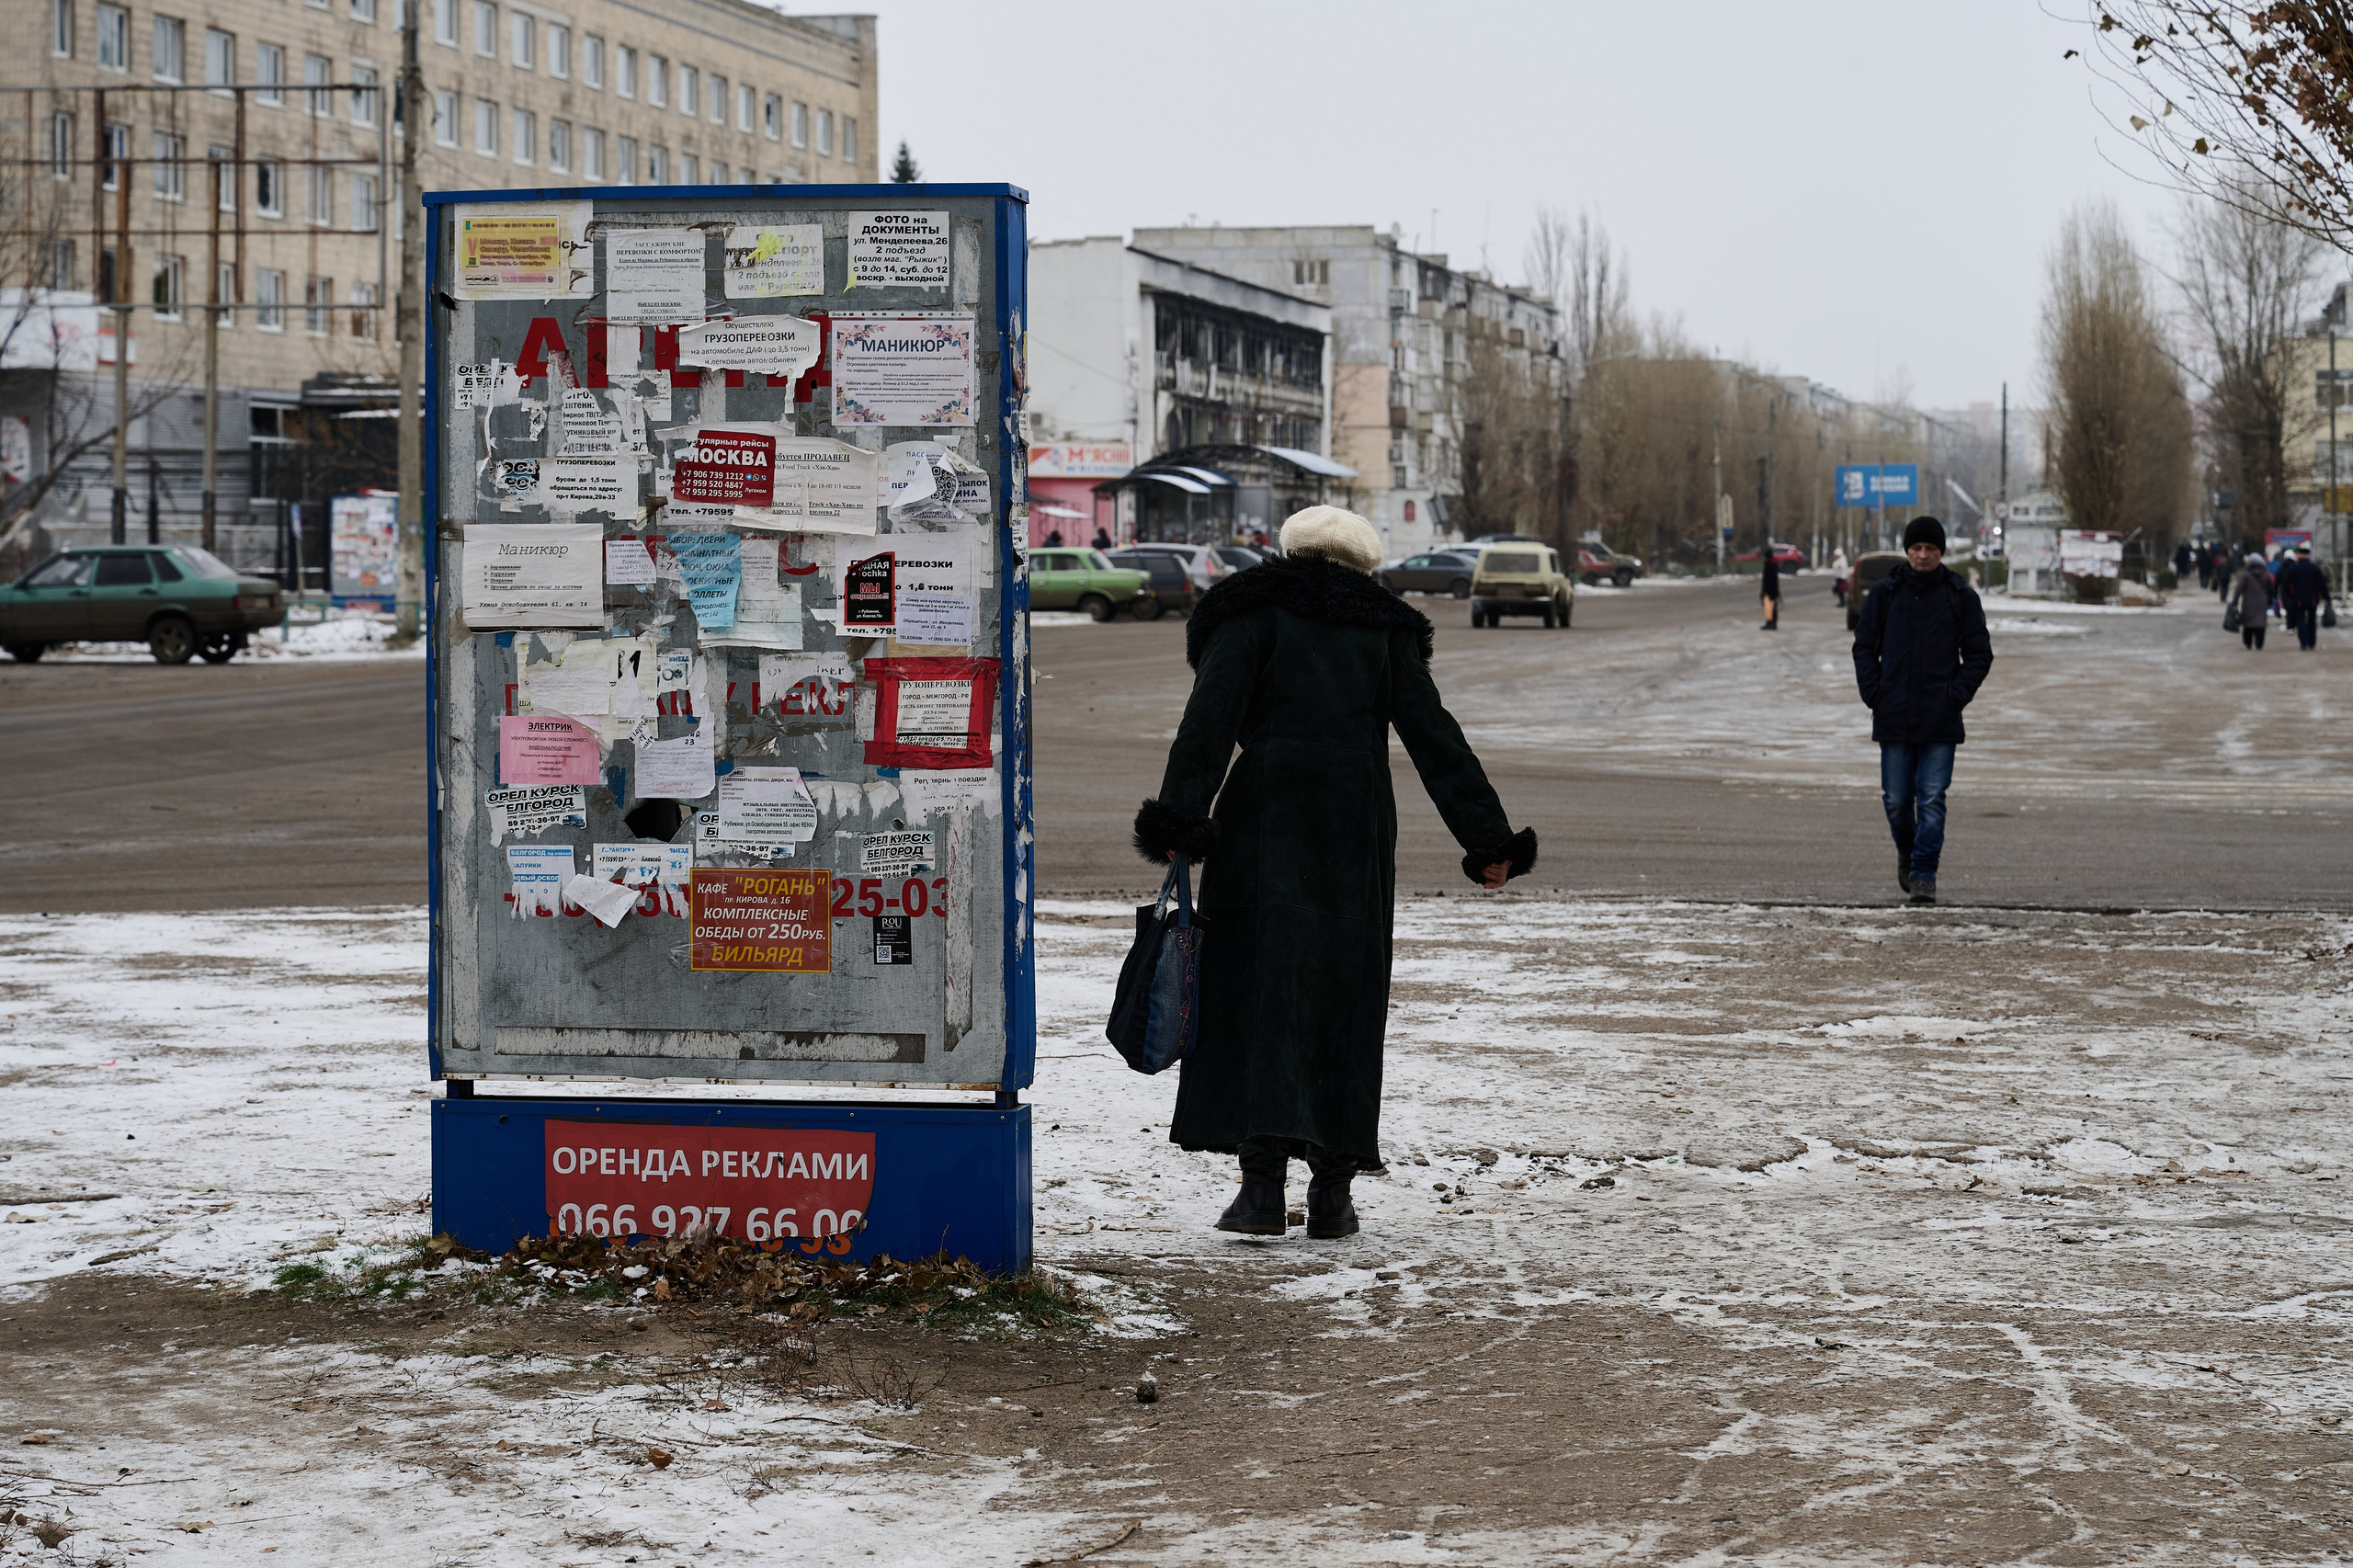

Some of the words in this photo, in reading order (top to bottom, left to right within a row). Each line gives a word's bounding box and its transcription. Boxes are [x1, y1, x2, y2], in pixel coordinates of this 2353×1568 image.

[874, 215, 910, 224] ФОТО
[862, 226, 939, 235] ДОКУМЕНТЫ
[853, 238, 867, 246] ул.
[885, 246, 926, 255] подъезд
[854, 256, 881, 264] (возле
[901, 266, 920, 275] суб.
[895, 275, 945, 283] выходной
[704, 332, 796, 344] ГРУЗОПЕРЕВОЗКИ
[746, 346, 763, 355] ДАФ
[778, 346, 789, 354] 3,5
[861, 339, 946, 353] МАНИКЮР
[741, 439, 769, 448] рейсы
[803, 452, 850, 462] ПРОДАВЕЦ
[693, 471, 708, 479] 906
[710, 471, 724, 479] 739
[726, 472, 745, 481] 1212
[692, 480, 708, 488] 959
[709, 480, 723, 488] 520
[708, 489, 722, 497] 295
[724, 489, 744, 498] 5995
[697, 536, 726, 545] ДВЕРИ
[498, 544, 569, 558] Маникюр
[860, 583, 881, 594] МЫ
[899, 680, 973, 688] ГРУЗОПЕРЕВОЗКИ
[528, 722, 574, 732] ЭЛЕКТРИК
[958, 776, 987, 784] поездки
[488, 790, 528, 804] ОРЕЛ
[529, 785, 582, 800] КУРСК
[890, 833, 933, 846] КУРСК
[867, 846, 925, 861] БЕЛГОРОД
[697, 882, 729, 894] КАФЕ
[735, 877, 825, 896] "РОГАНЬ"
[704, 908, 809, 921] КОМПЛЕКСНЫЕ
[695, 926, 744, 940] ОБЕДЫ
[747, 927, 766, 939] ОТ
[712, 945, 803, 967] БИЛЬЯРД
[552, 1147, 692, 1182] ОРЕНДА
[702, 1150, 869, 1181] РЕКЛАМИ
[559, 1202, 638, 1239] 066
[652, 1205, 731, 1240] 927
[746, 1207, 799, 1242] 66
